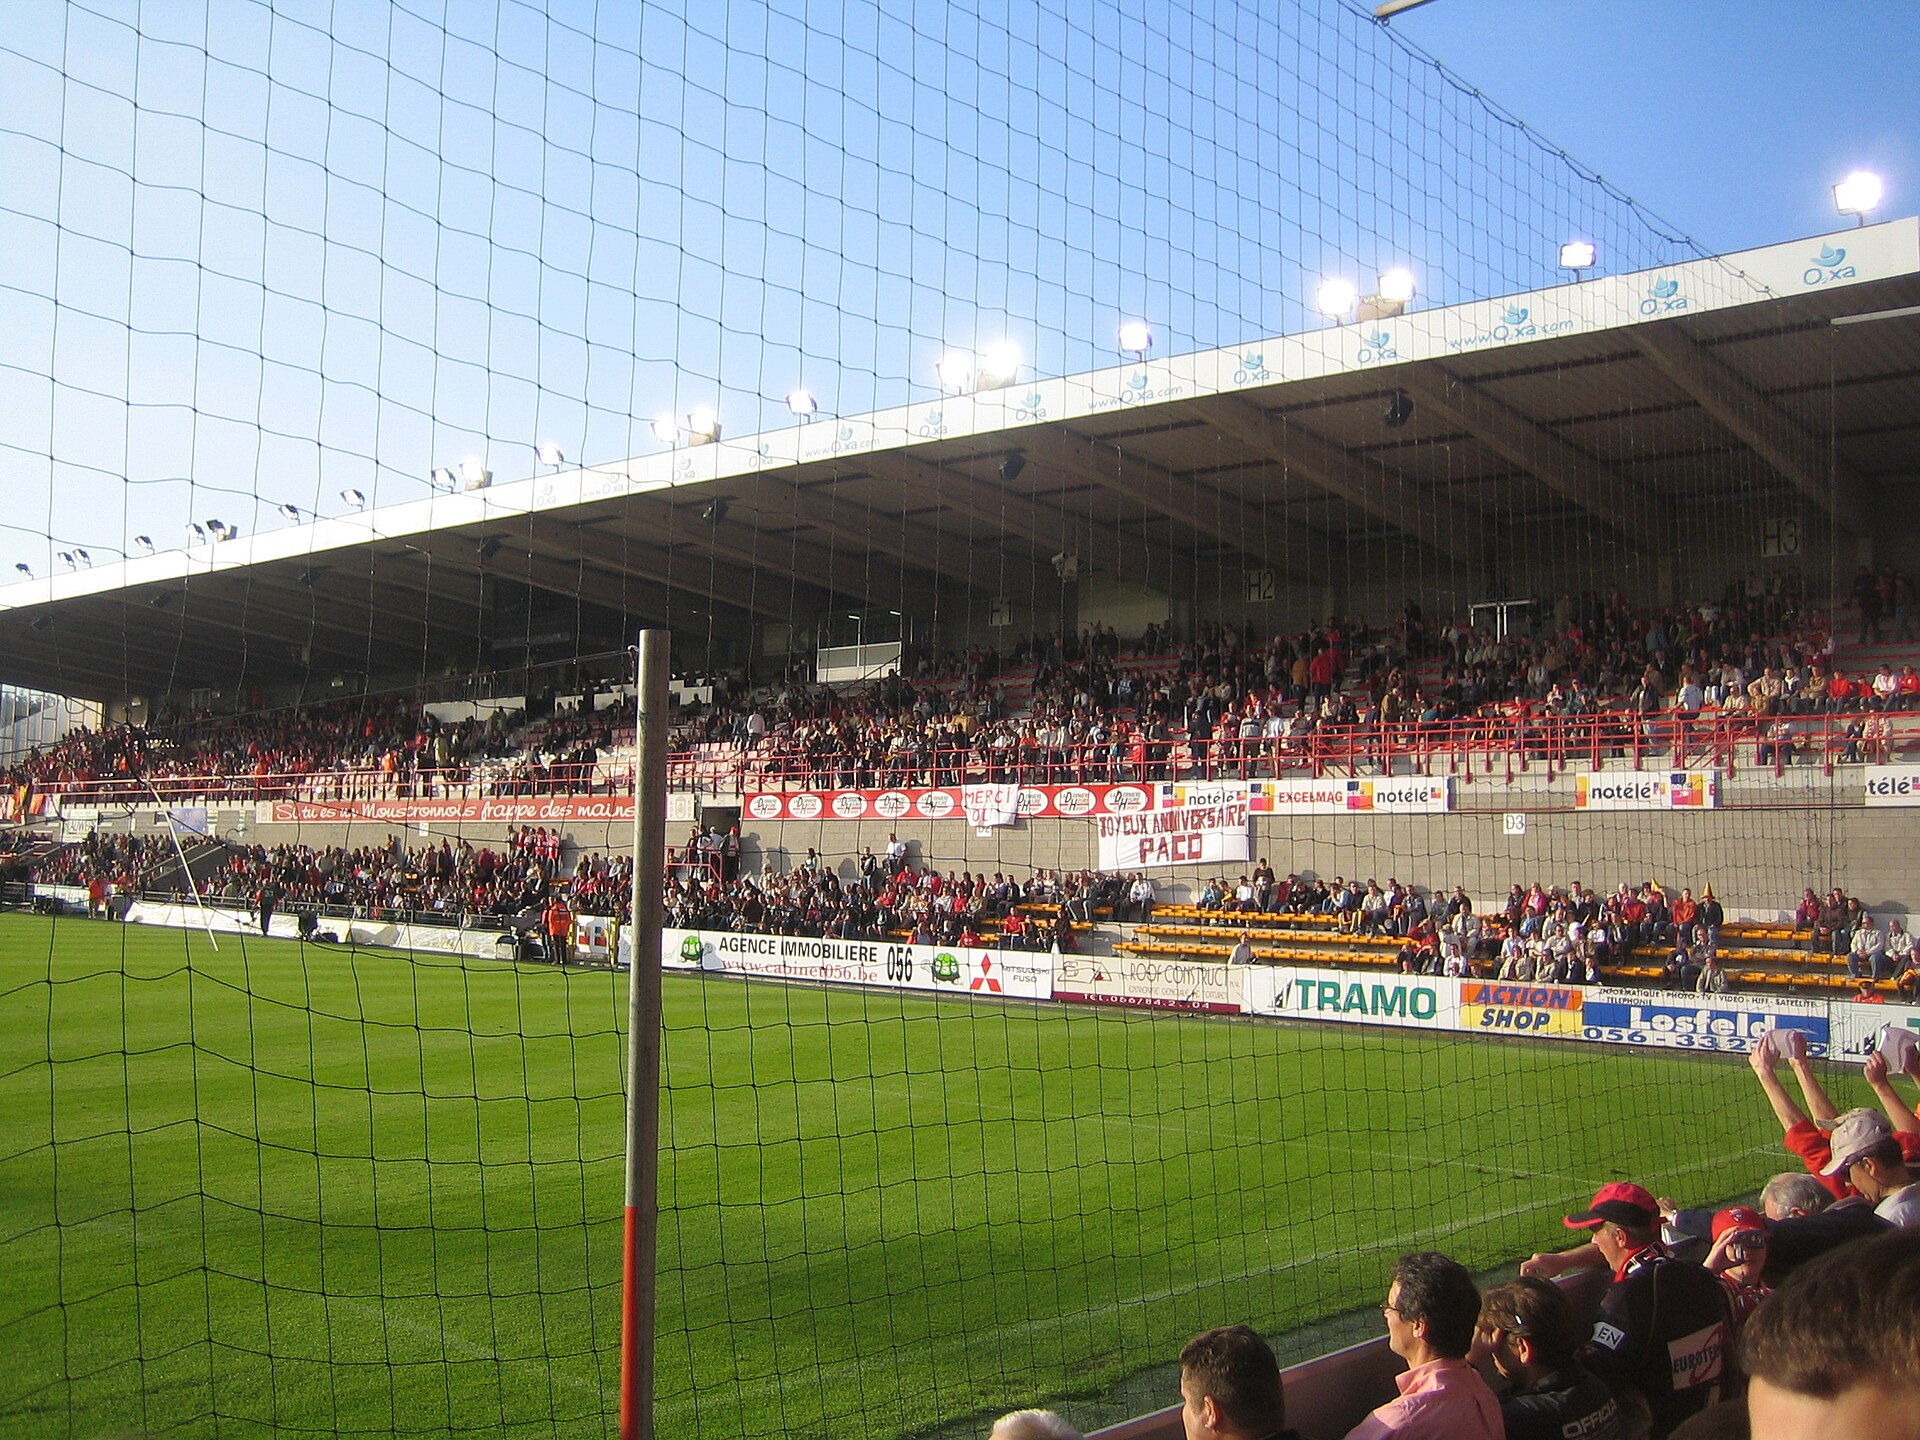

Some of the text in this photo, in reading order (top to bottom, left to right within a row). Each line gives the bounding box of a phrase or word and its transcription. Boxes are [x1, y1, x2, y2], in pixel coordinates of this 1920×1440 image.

[1763, 518, 1798, 555] H3
[1247, 571, 1273, 600] H2
[1189, 791, 1233, 806] notélé
[1278, 791, 1343, 803] EXCELMAG
[1377, 788, 1429, 803] notélé
[1591, 782, 1651, 799] notélé
[301, 805, 318, 818] tu
[319, 808, 337, 819] es
[361, 801, 477, 819] Mouscronnois
[481, 800, 537, 820] frappe
[540, 799, 574, 818] des
[1099, 803, 1247, 838] JOYEUX ANNIVERSAIRE
[1505, 815, 1524, 830] D3
[1139, 833, 1202, 863] PACO
[719, 936, 878, 963] AGENCE IMMOBILIERE
[720, 959, 878, 983] www.cabinet056.be
[887, 946, 913, 982] 056
[1013, 975, 1037, 983] FUSO
[1295, 979, 1437, 1020] TRAMO
[1475, 986, 1571, 1008] ACTION
[1600, 988, 1660, 999] INFORMATIQUE
[1666, 991, 1694, 1000] PHOTO
[1700, 993, 1711, 1001] TV
[1719, 994, 1744, 1003] VIDEO
[1480, 1009, 1551, 1030] SHOP
[1629, 1006, 1777, 1039] Losfeld
